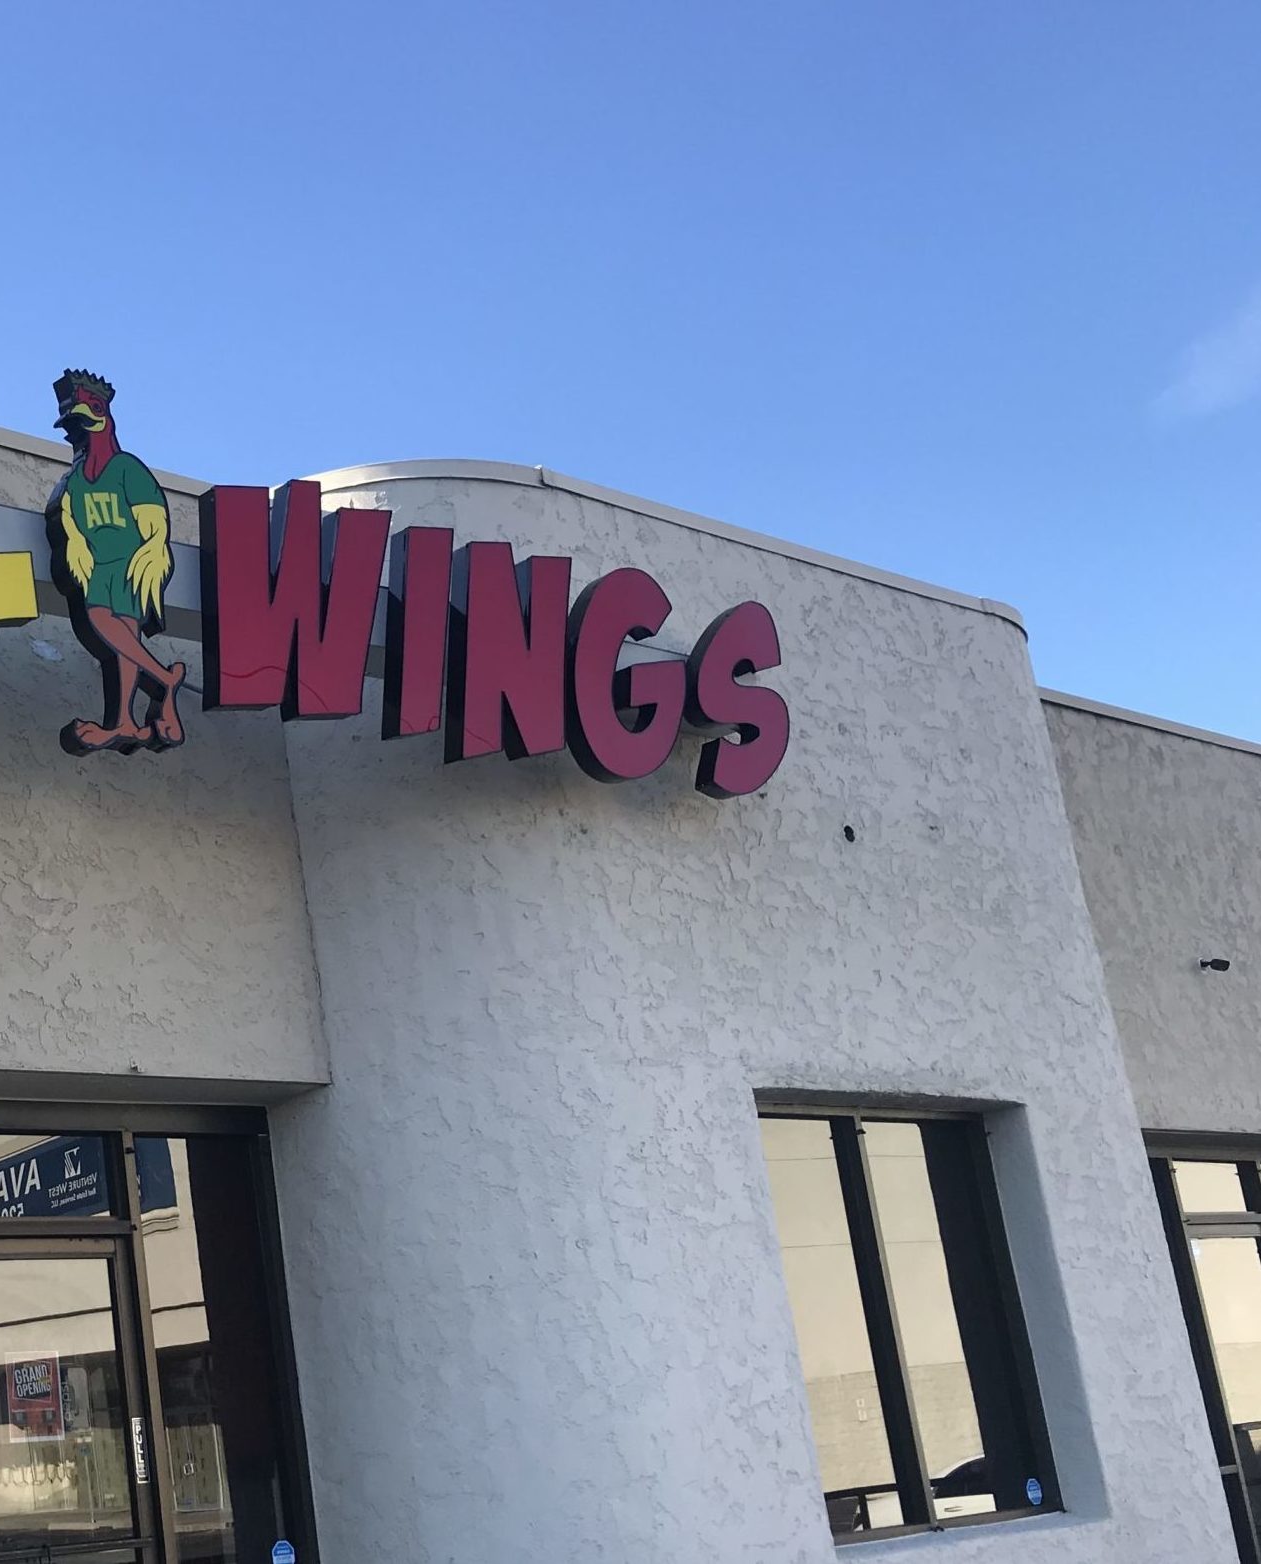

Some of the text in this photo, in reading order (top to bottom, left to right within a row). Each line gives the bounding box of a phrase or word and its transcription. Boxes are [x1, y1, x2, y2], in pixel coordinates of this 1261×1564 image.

[84, 492, 126, 529] ATL
[200, 479, 790, 799] WINGS
[15, 1364, 48, 1385] GRAND
[16, 1382, 52, 1398] OPENING
[135, 1425, 145, 1463] PULL
